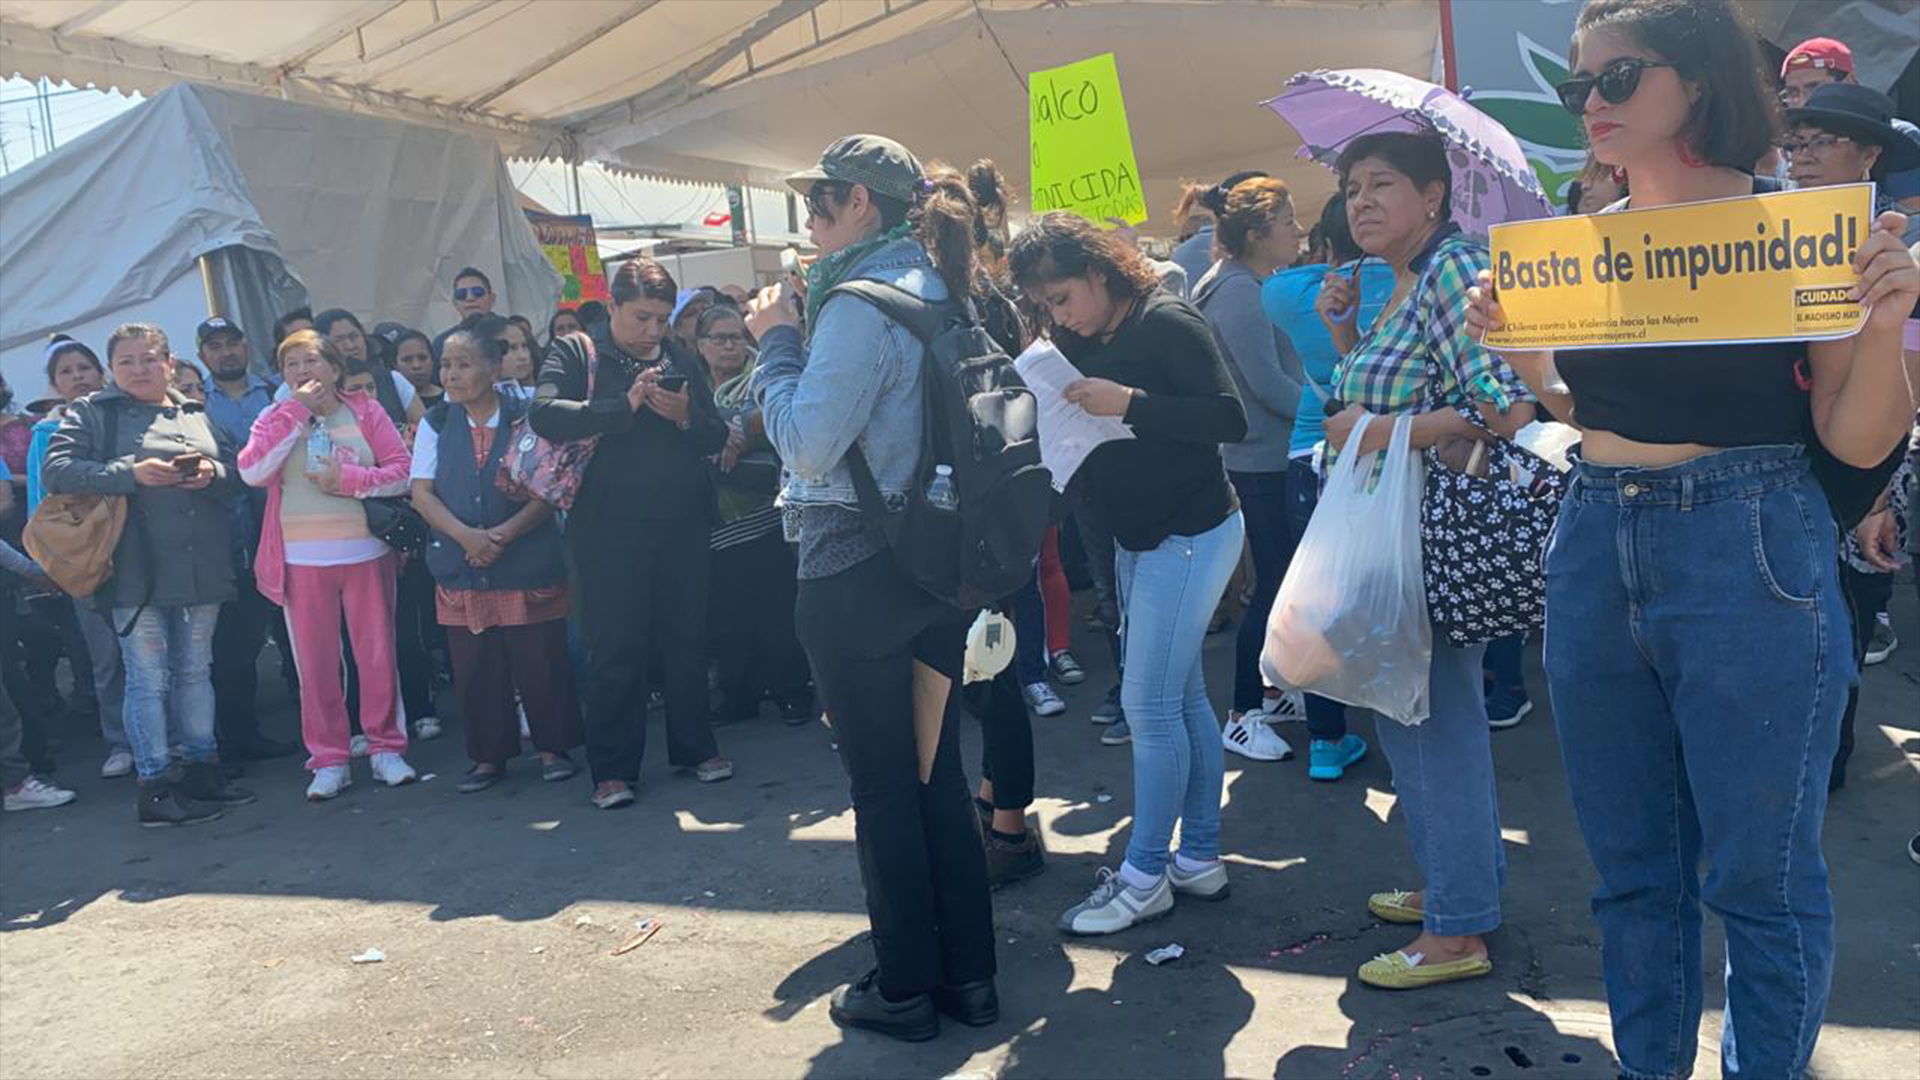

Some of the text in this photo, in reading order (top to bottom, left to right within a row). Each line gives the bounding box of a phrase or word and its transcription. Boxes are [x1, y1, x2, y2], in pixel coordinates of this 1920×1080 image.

[1593, 236, 1634, 284] de
[1643, 213, 1858, 290] impunidad!
[1796, 289, 1850, 306] ¡CUIDAD
[1507, 322, 1537, 332] Chilena
[1540, 321, 1566, 331] contra
[1567, 318, 1577, 329] la
[1578, 318, 1618, 328] Violencia
[1620, 316, 1645, 327] hacia
[1646, 315, 1660, 325] las
[1661, 315, 1699, 327] Mujeres
[1796, 313, 1803, 322] EL
[1804, 311, 1841, 322] MACHISMO
